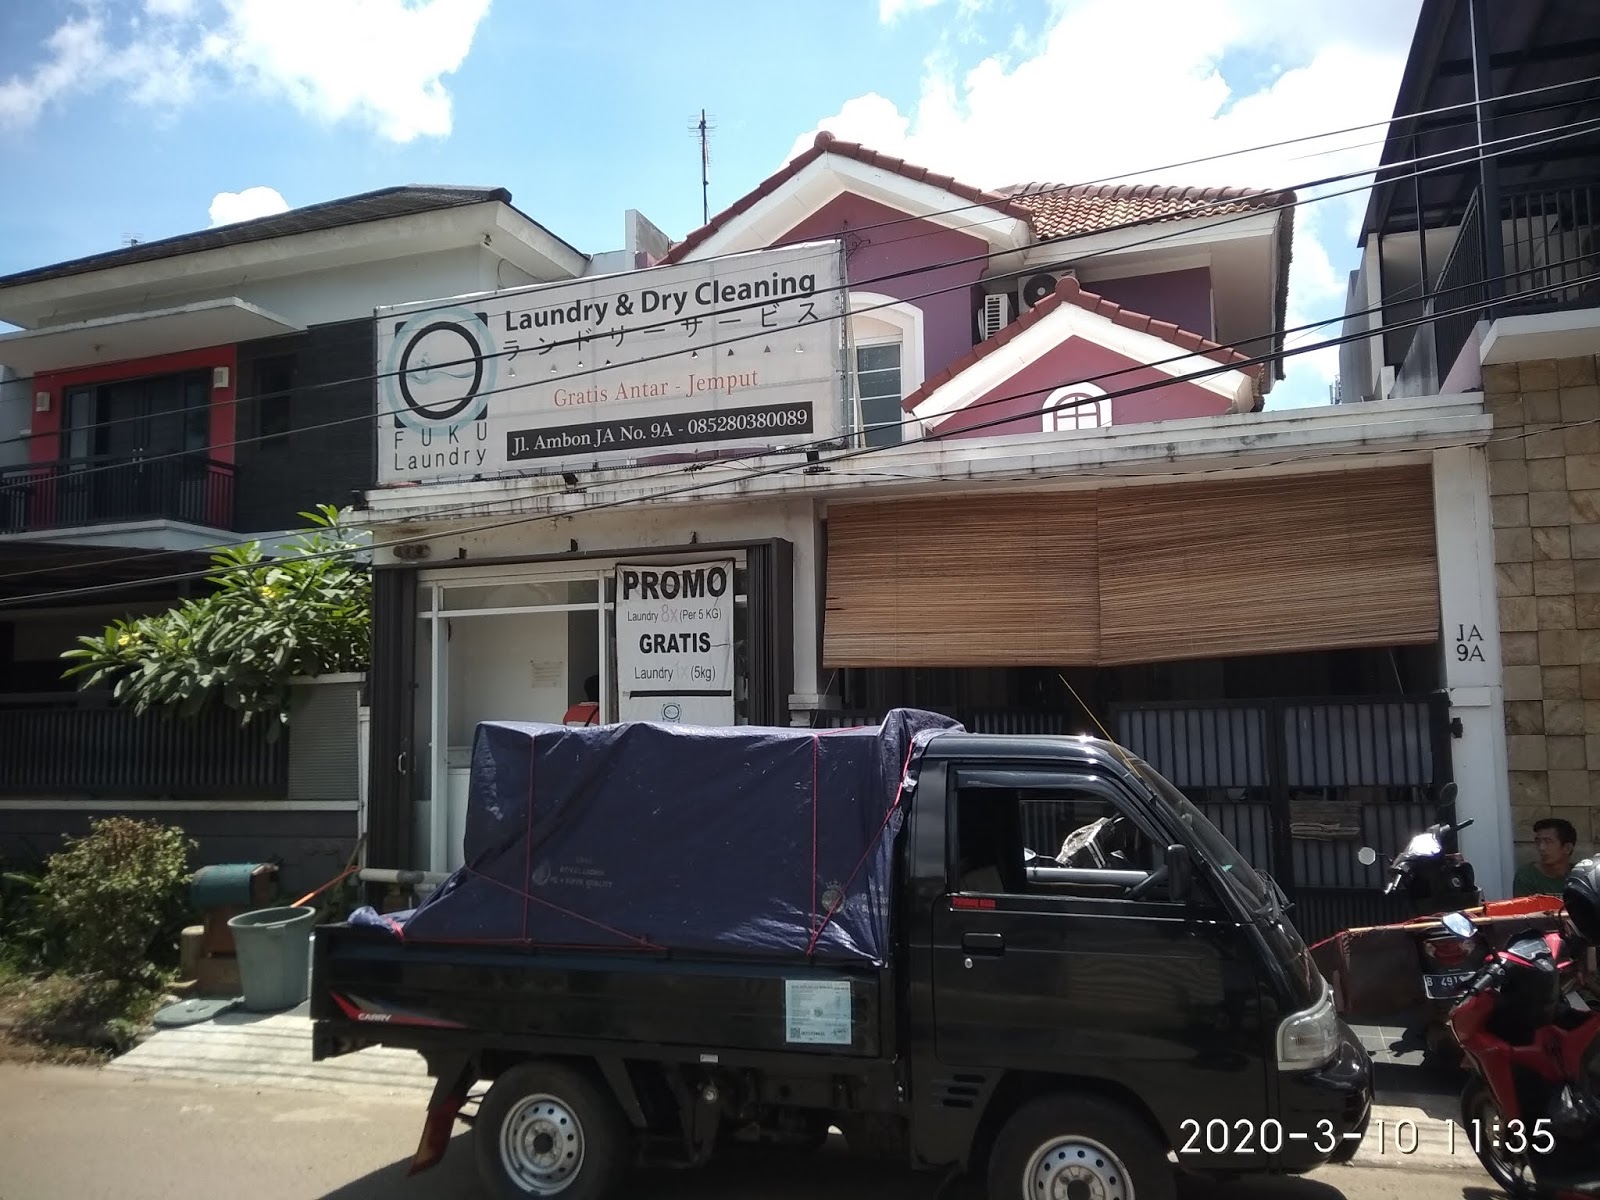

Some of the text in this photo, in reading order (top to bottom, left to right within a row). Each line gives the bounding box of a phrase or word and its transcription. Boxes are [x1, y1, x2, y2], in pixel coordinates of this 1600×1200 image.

[506, 272, 815, 331] Laundry & Dry Cleaning
[554, 385, 608, 407] Gratis
[615, 381, 668, 401] Antar
[686, 370, 758, 398] Jemput
[395, 422, 487, 449] FUKU
[512, 437, 529, 456] Jl.
[534, 432, 591, 450] Ambon
[594, 425, 615, 448] JA
[620, 425, 646, 442] No.
[650, 421, 674, 438] 9A
[687, 409, 808, 435] 085280380089
[395, 447, 486, 471] Laundry
[623, 567, 727, 600] PROMO
[628, 611, 659, 623] Laundry
[679, 609, 697, 623] (Per
[698, 609, 704, 619] 5
[706, 608, 722, 621] KG)
[640, 632, 711, 653] GRATIS
[1456, 624, 1485, 641] JA
[1456, 644, 1486, 661] 9A
[635, 667, 673, 682] Laundry
[690, 666, 716, 682] (5kg)
[1426, 977, 1434, 987] B
[358, 1012, 393, 1022] CARRY
